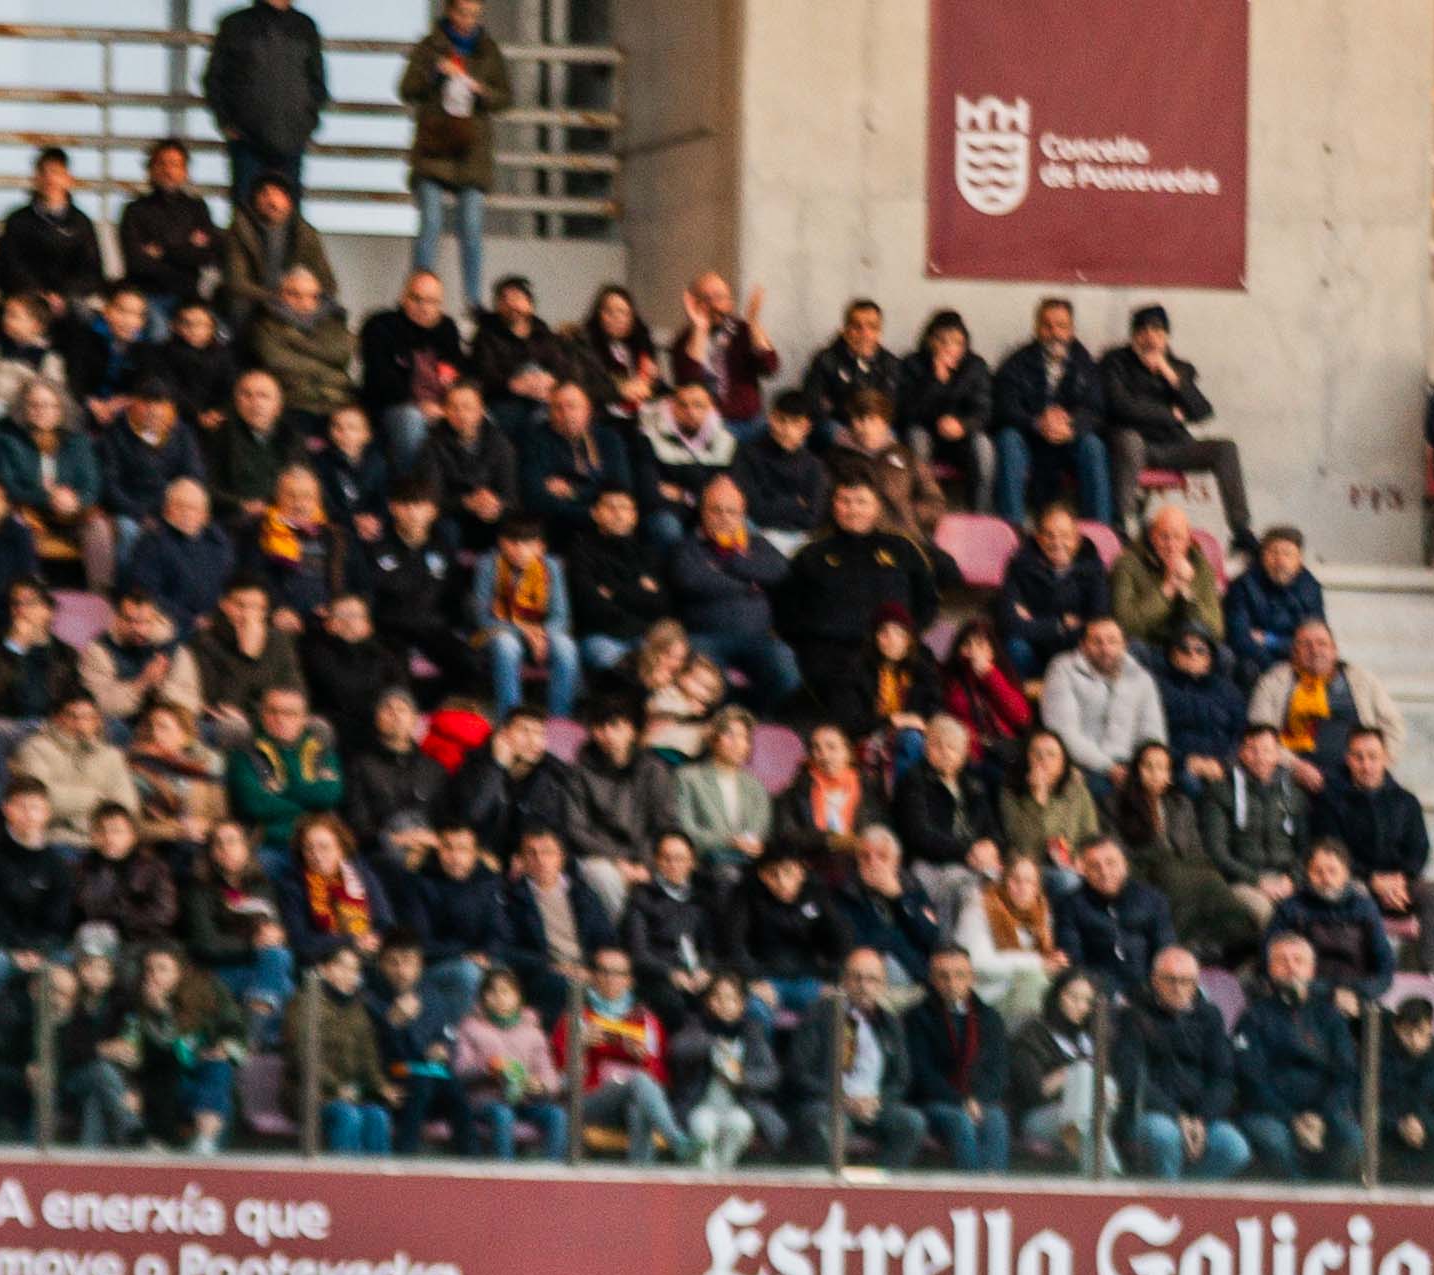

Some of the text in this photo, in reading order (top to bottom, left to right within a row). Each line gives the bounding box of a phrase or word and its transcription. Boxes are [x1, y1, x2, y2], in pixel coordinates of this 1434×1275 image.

[1039, 132, 1150, 164] Concello
[1038, 162, 1221, 195] de Pontevedra
[41, 1183, 227, 1238] enerxía
[233, 1194, 330, 1246] que
